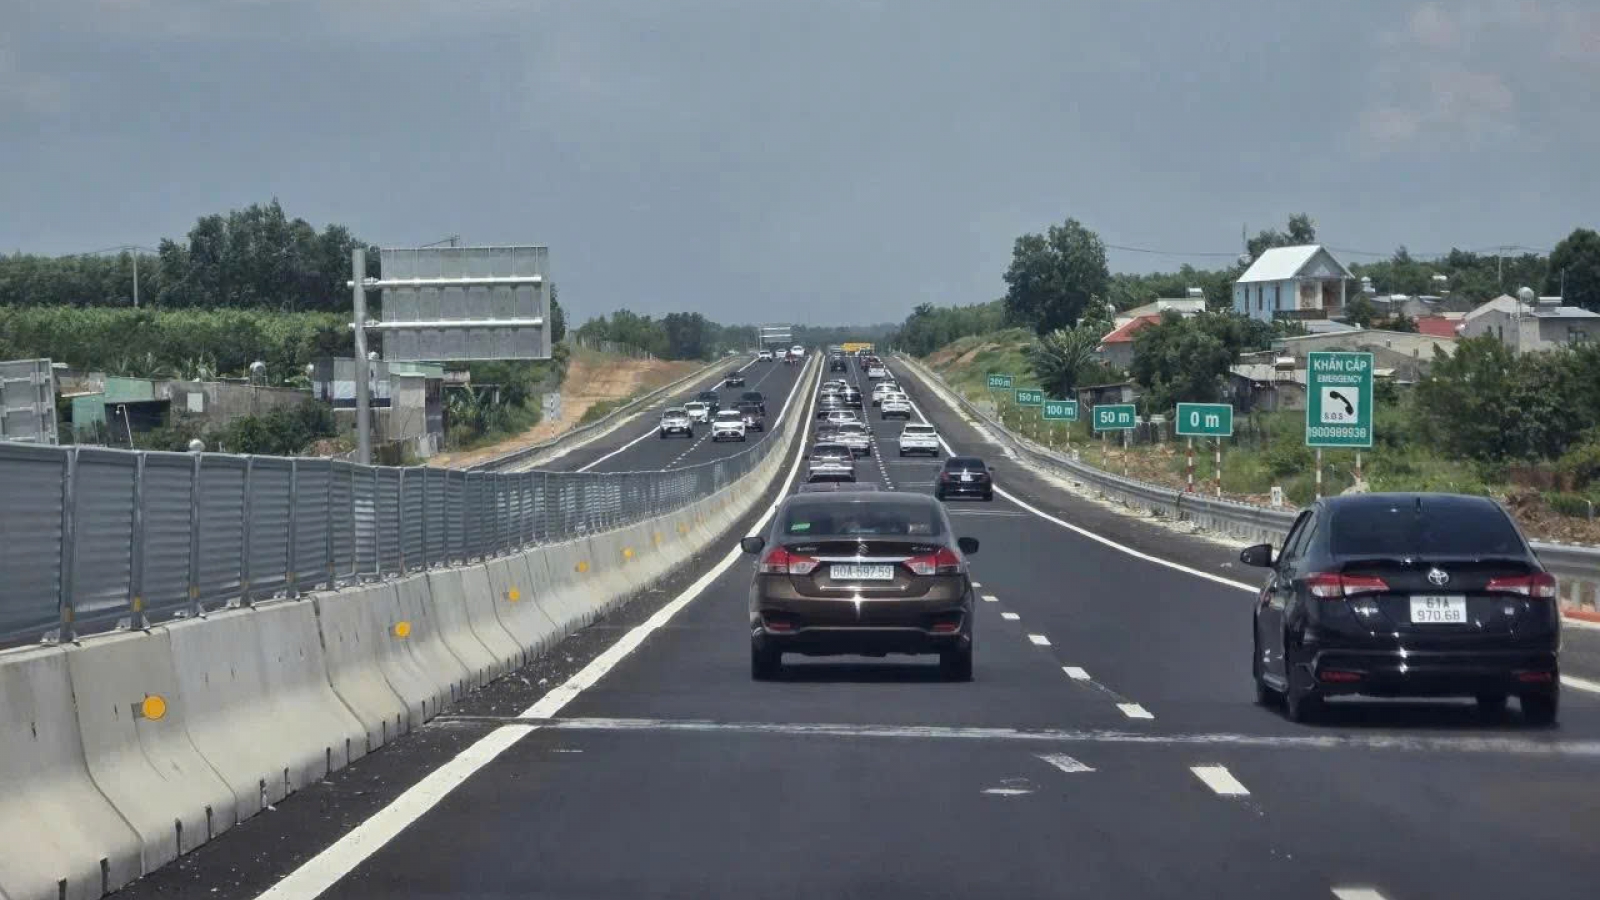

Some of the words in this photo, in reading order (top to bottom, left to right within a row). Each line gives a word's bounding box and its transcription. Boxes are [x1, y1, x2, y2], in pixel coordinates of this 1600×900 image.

[1317, 374, 1362, 383] EMERGENCY
[1019, 392, 1031, 402] 150
[1046, 405, 1062, 415] 100
[1065, 406, 1073, 415] m
[1100, 411, 1115, 423] 50
[1118, 413, 1130, 423] m
[1190, 411, 1200, 427] 0
[1205, 413, 1220, 428] m
[1426, 597, 1450, 609] 61A
